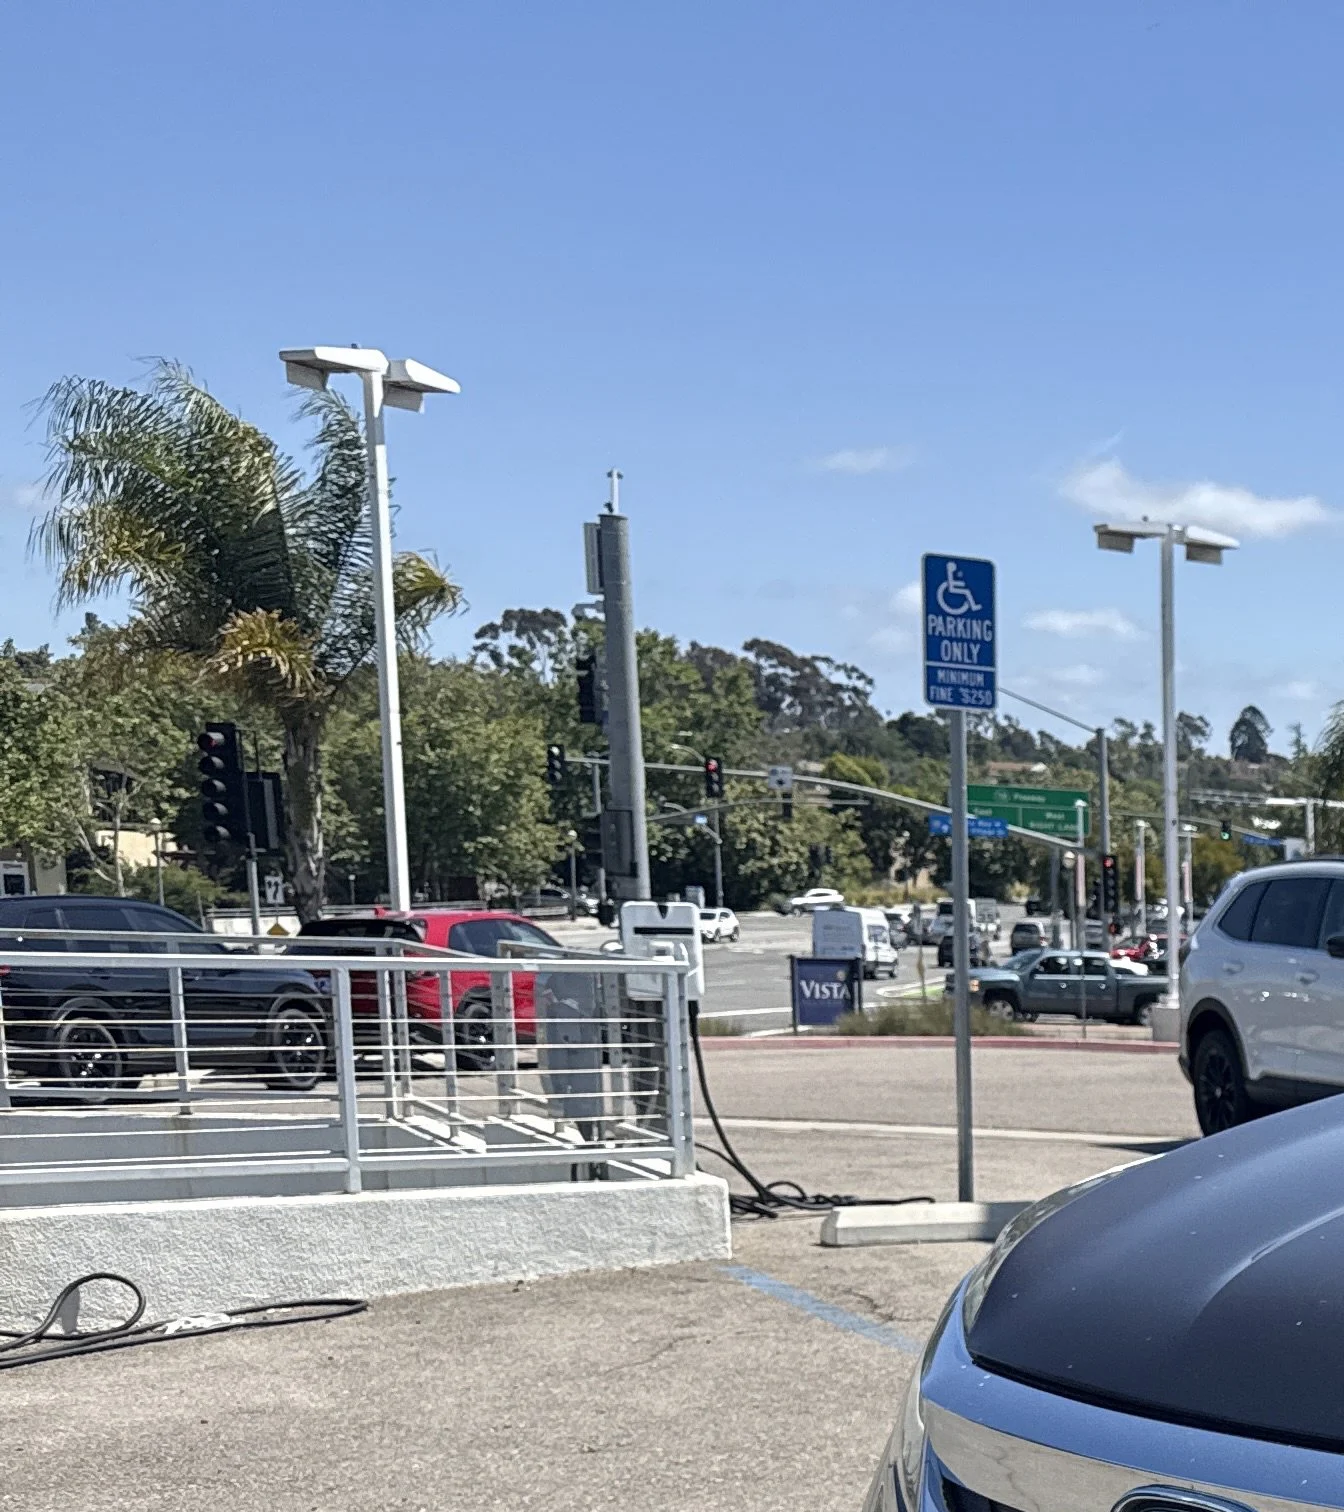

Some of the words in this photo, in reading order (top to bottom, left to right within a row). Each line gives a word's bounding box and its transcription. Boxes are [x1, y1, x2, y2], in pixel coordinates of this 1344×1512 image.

[928, 614, 992, 641] PARKING
[940, 640, 980, 664] ONLY
[937, 669, 984, 685] MINIMUM
[930, 686, 952, 701] FINE
[960, 688, 992, 706] $250
[800, 980, 851, 999] VISTA
